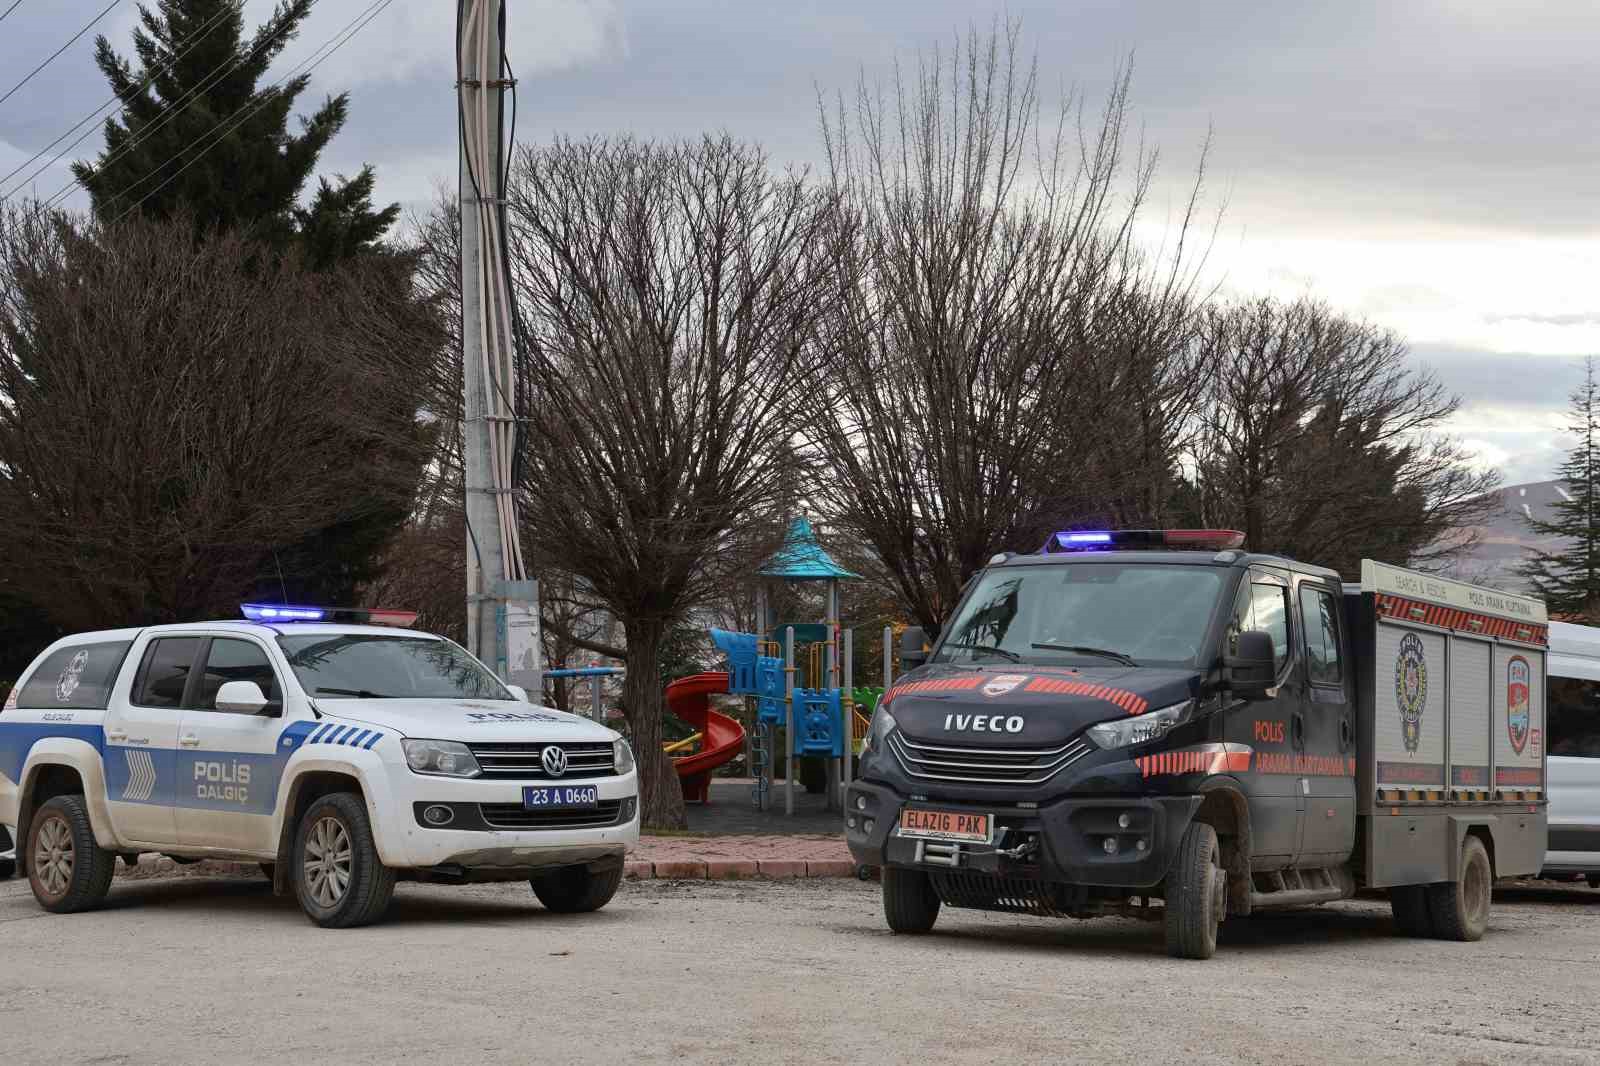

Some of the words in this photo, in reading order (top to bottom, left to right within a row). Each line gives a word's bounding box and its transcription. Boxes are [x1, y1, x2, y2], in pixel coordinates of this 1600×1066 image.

[944, 714, 1024, 733] IVECO
[194, 759, 251, 784] POLİS
[197, 785, 248, 805] DALGIÇ
[532, 788, 548, 804] 23
[553, 789, 562, 804] A
[566, 788, 595, 804] 0660
[907, 811, 950, 831] ELAZIG
[958, 816, 981, 834] PAK
